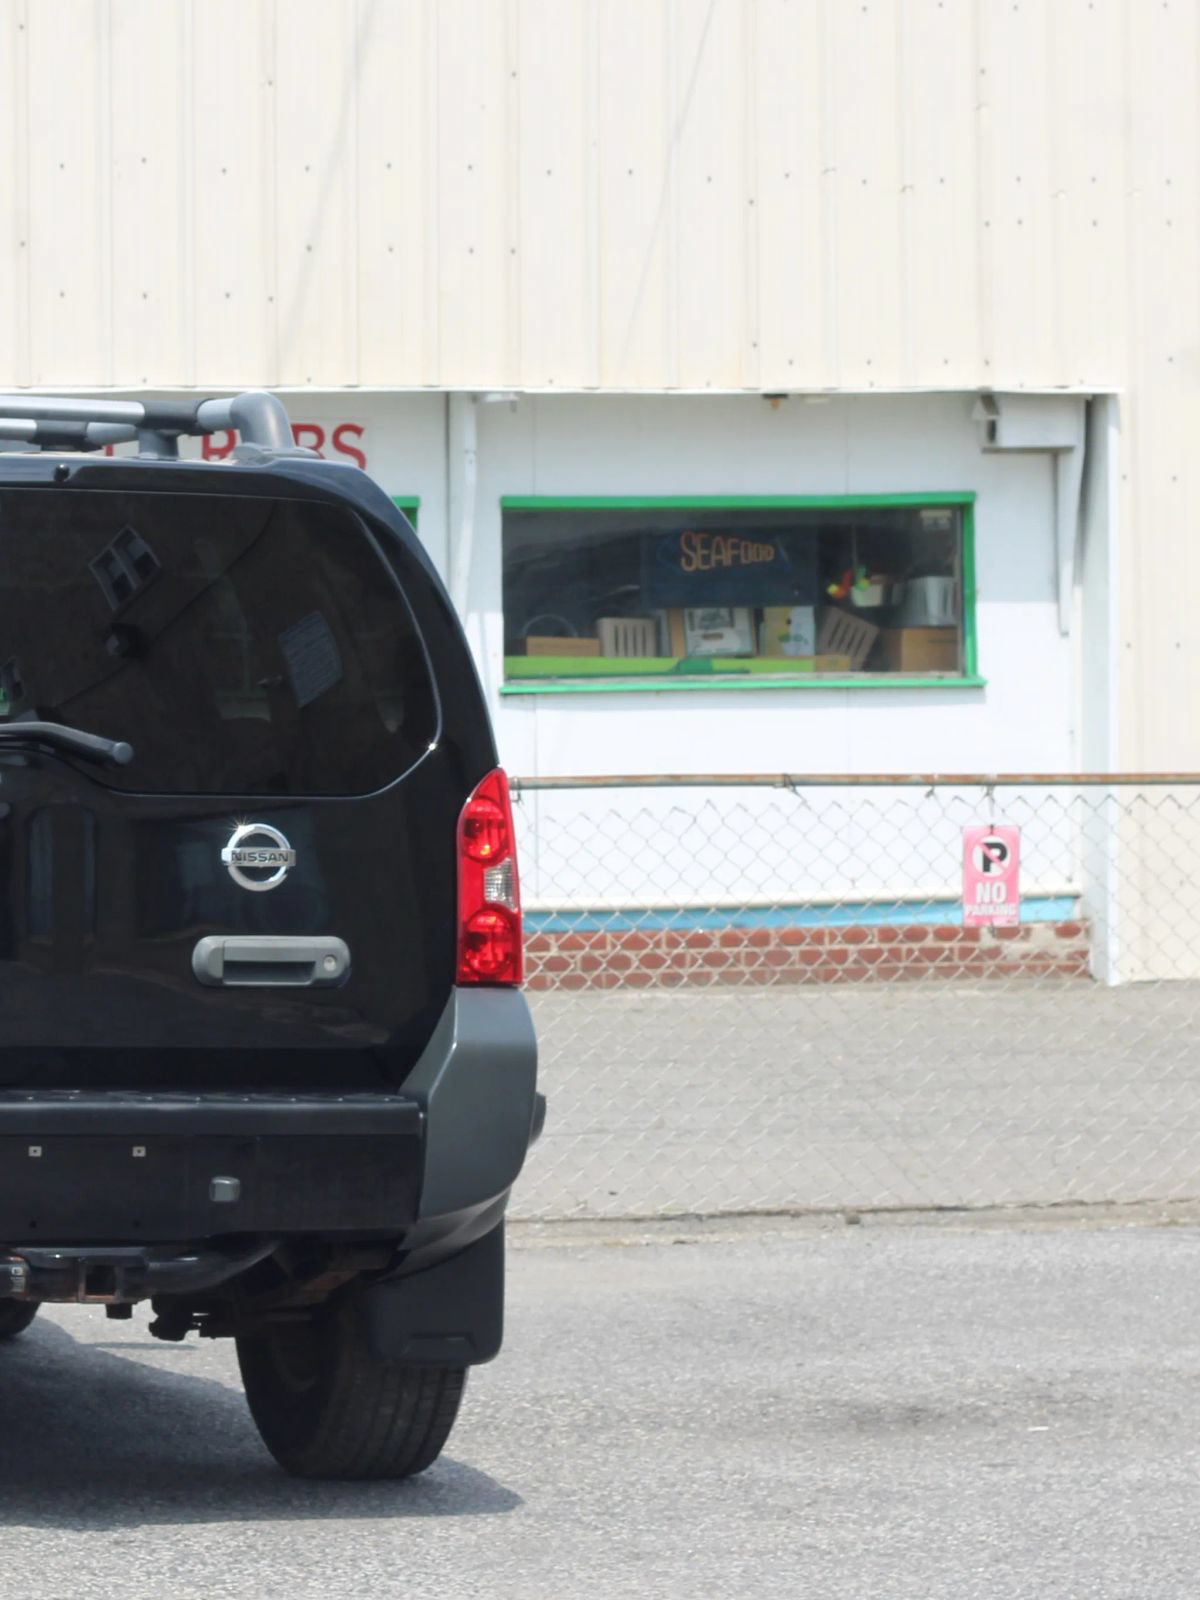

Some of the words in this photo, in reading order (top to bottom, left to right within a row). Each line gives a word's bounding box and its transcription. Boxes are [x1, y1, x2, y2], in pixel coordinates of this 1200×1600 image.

[679, 530, 776, 573] SEAFOOD
[231, 851, 289, 863] NISSAN
[975, 881, 1007, 904] NO
